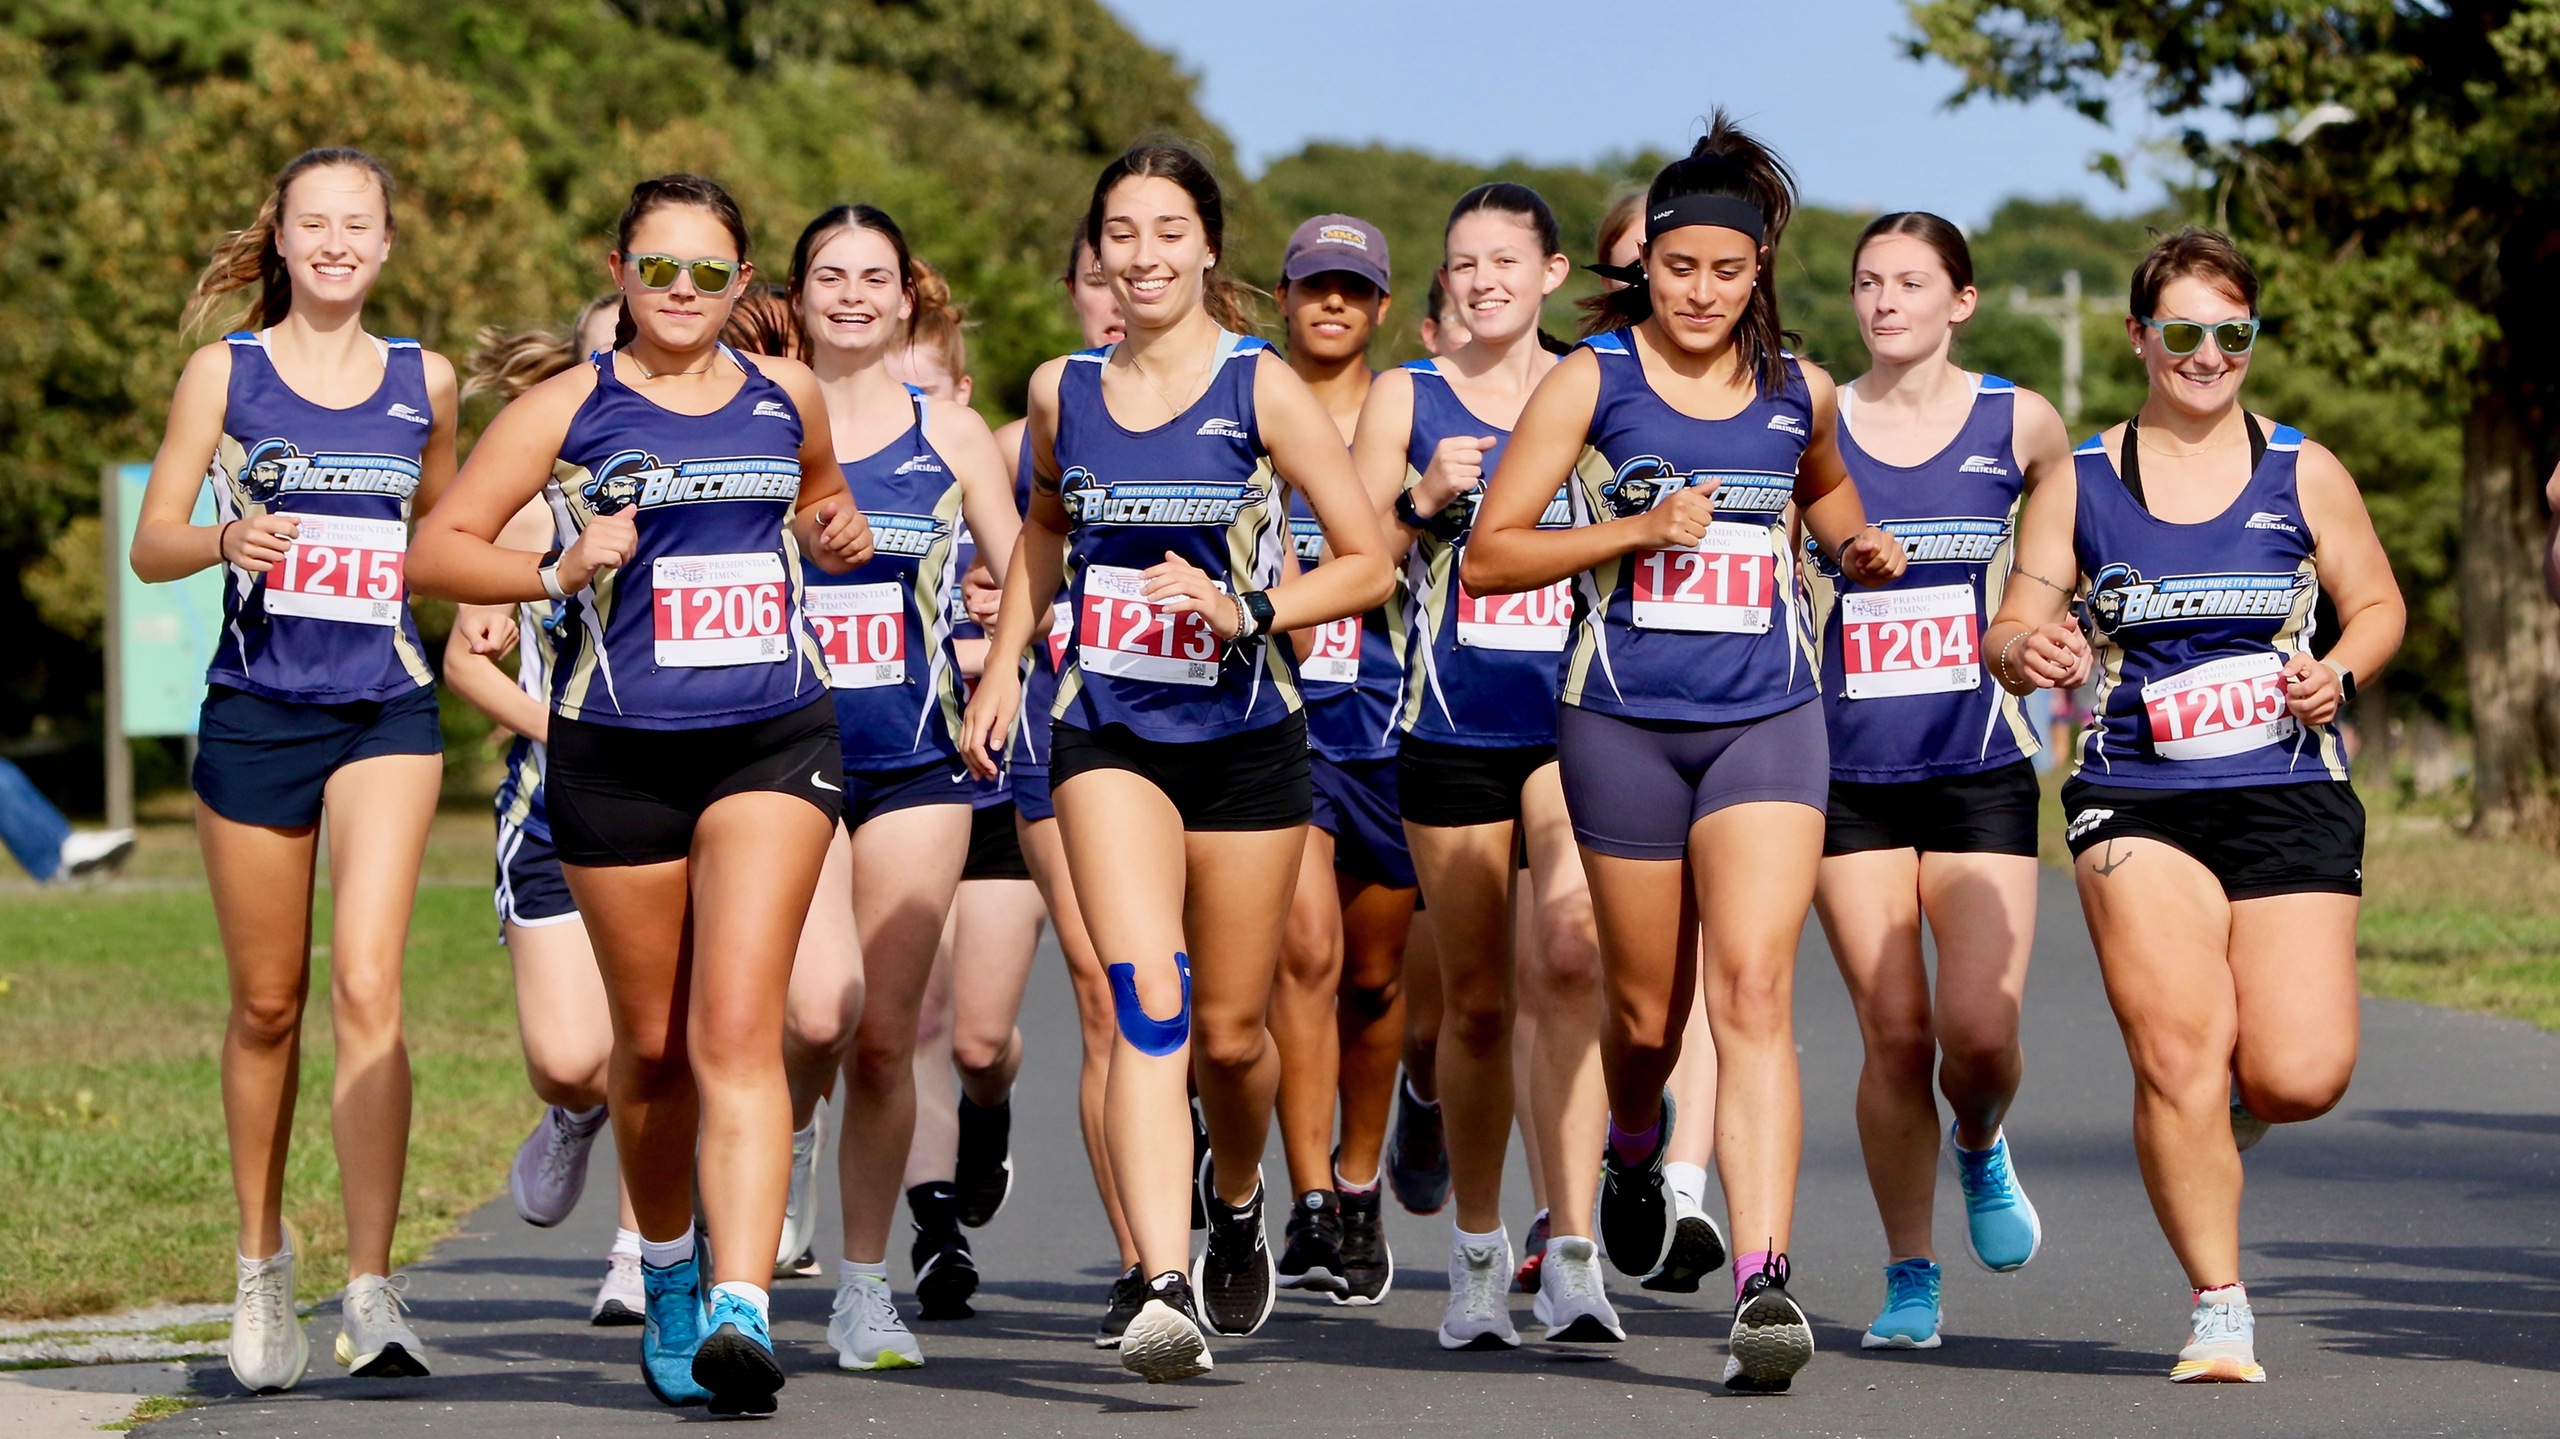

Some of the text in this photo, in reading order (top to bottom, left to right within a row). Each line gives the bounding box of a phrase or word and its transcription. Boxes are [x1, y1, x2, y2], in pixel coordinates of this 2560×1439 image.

[685, 461, 766, 474] MASSACHUSETTS
[275, 458, 419, 498] BUCCANEERS
[1696, 475, 1768, 485] MAACHUSETTS
[629, 468, 801, 506] BUCCANEERS
[1115, 486, 1242, 498] MASSACHUSETTS MARITIME
[1645, 477, 1793, 510] BCANEERS
[1074, 488, 1254, 523] BUCCANEERS
[327, 522, 396, 535] PRESIDENTIAL
[1708, 528, 1761, 539] ESIDENTIAL
[1886, 522, 2001, 534] MASSACHUSETTS MARITIME
[326, 532, 362, 542] TIMING
[1699, 538, 1730, 547] IMING
[708, 559, 770, 570] PRESIDENTIAL
[283, 545, 398, 600] 1215
[709, 571, 743, 580] TIMING
[1643, 552, 1761, 606] 1211
[2164, 577, 2293, 590] MASSACHUSETTS MARITIME
[820, 590, 889, 600] PRESIDENTIAL
[1893, 592, 1963, 604] PRESIDENTIAL
[820, 602, 857, 610] TIMING
[1894, 604, 1930, 614] TIMING
[2115, 584, 2303, 623] BUCCANEERS
[661, 584, 781, 640] 1206
[1091, 598, 1215, 661] 1213
[809, 615, 898, 663] 210
[1850, 616, 1973, 672] 1204
[2155, 673, 2286, 740] 1205
